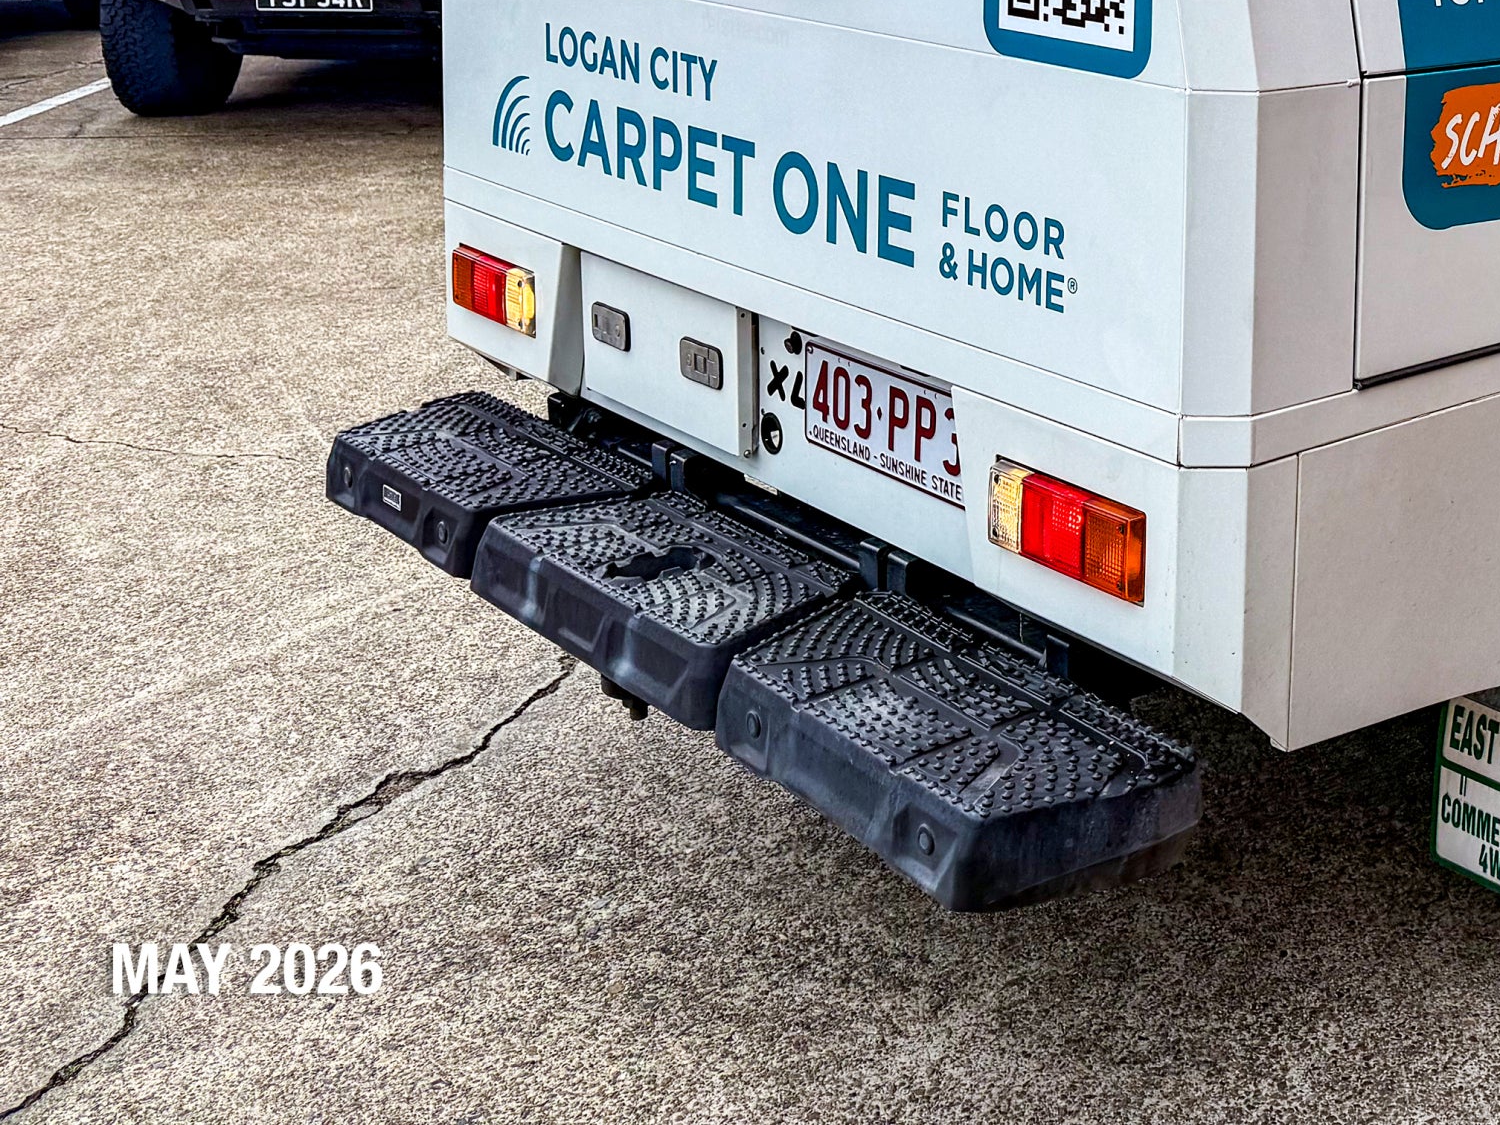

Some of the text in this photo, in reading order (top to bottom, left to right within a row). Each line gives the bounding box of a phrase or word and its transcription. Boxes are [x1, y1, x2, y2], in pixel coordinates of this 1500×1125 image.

[544, 22, 640, 83] LOGAN
[650, 52, 718, 102] CITY
[543, 89, 916, 268] CARPET ONE
[942, 191, 1065, 260] FLOOR
[939, 242, 958, 281] &
[767, 360, 806, 410] XL
[813, 425, 871, 461] QUEENSLAND
[879, 452, 929, 487] SUNSHINE
[931, 475, 963, 501] STATE
[1450, 704, 1500, 764] EAST
